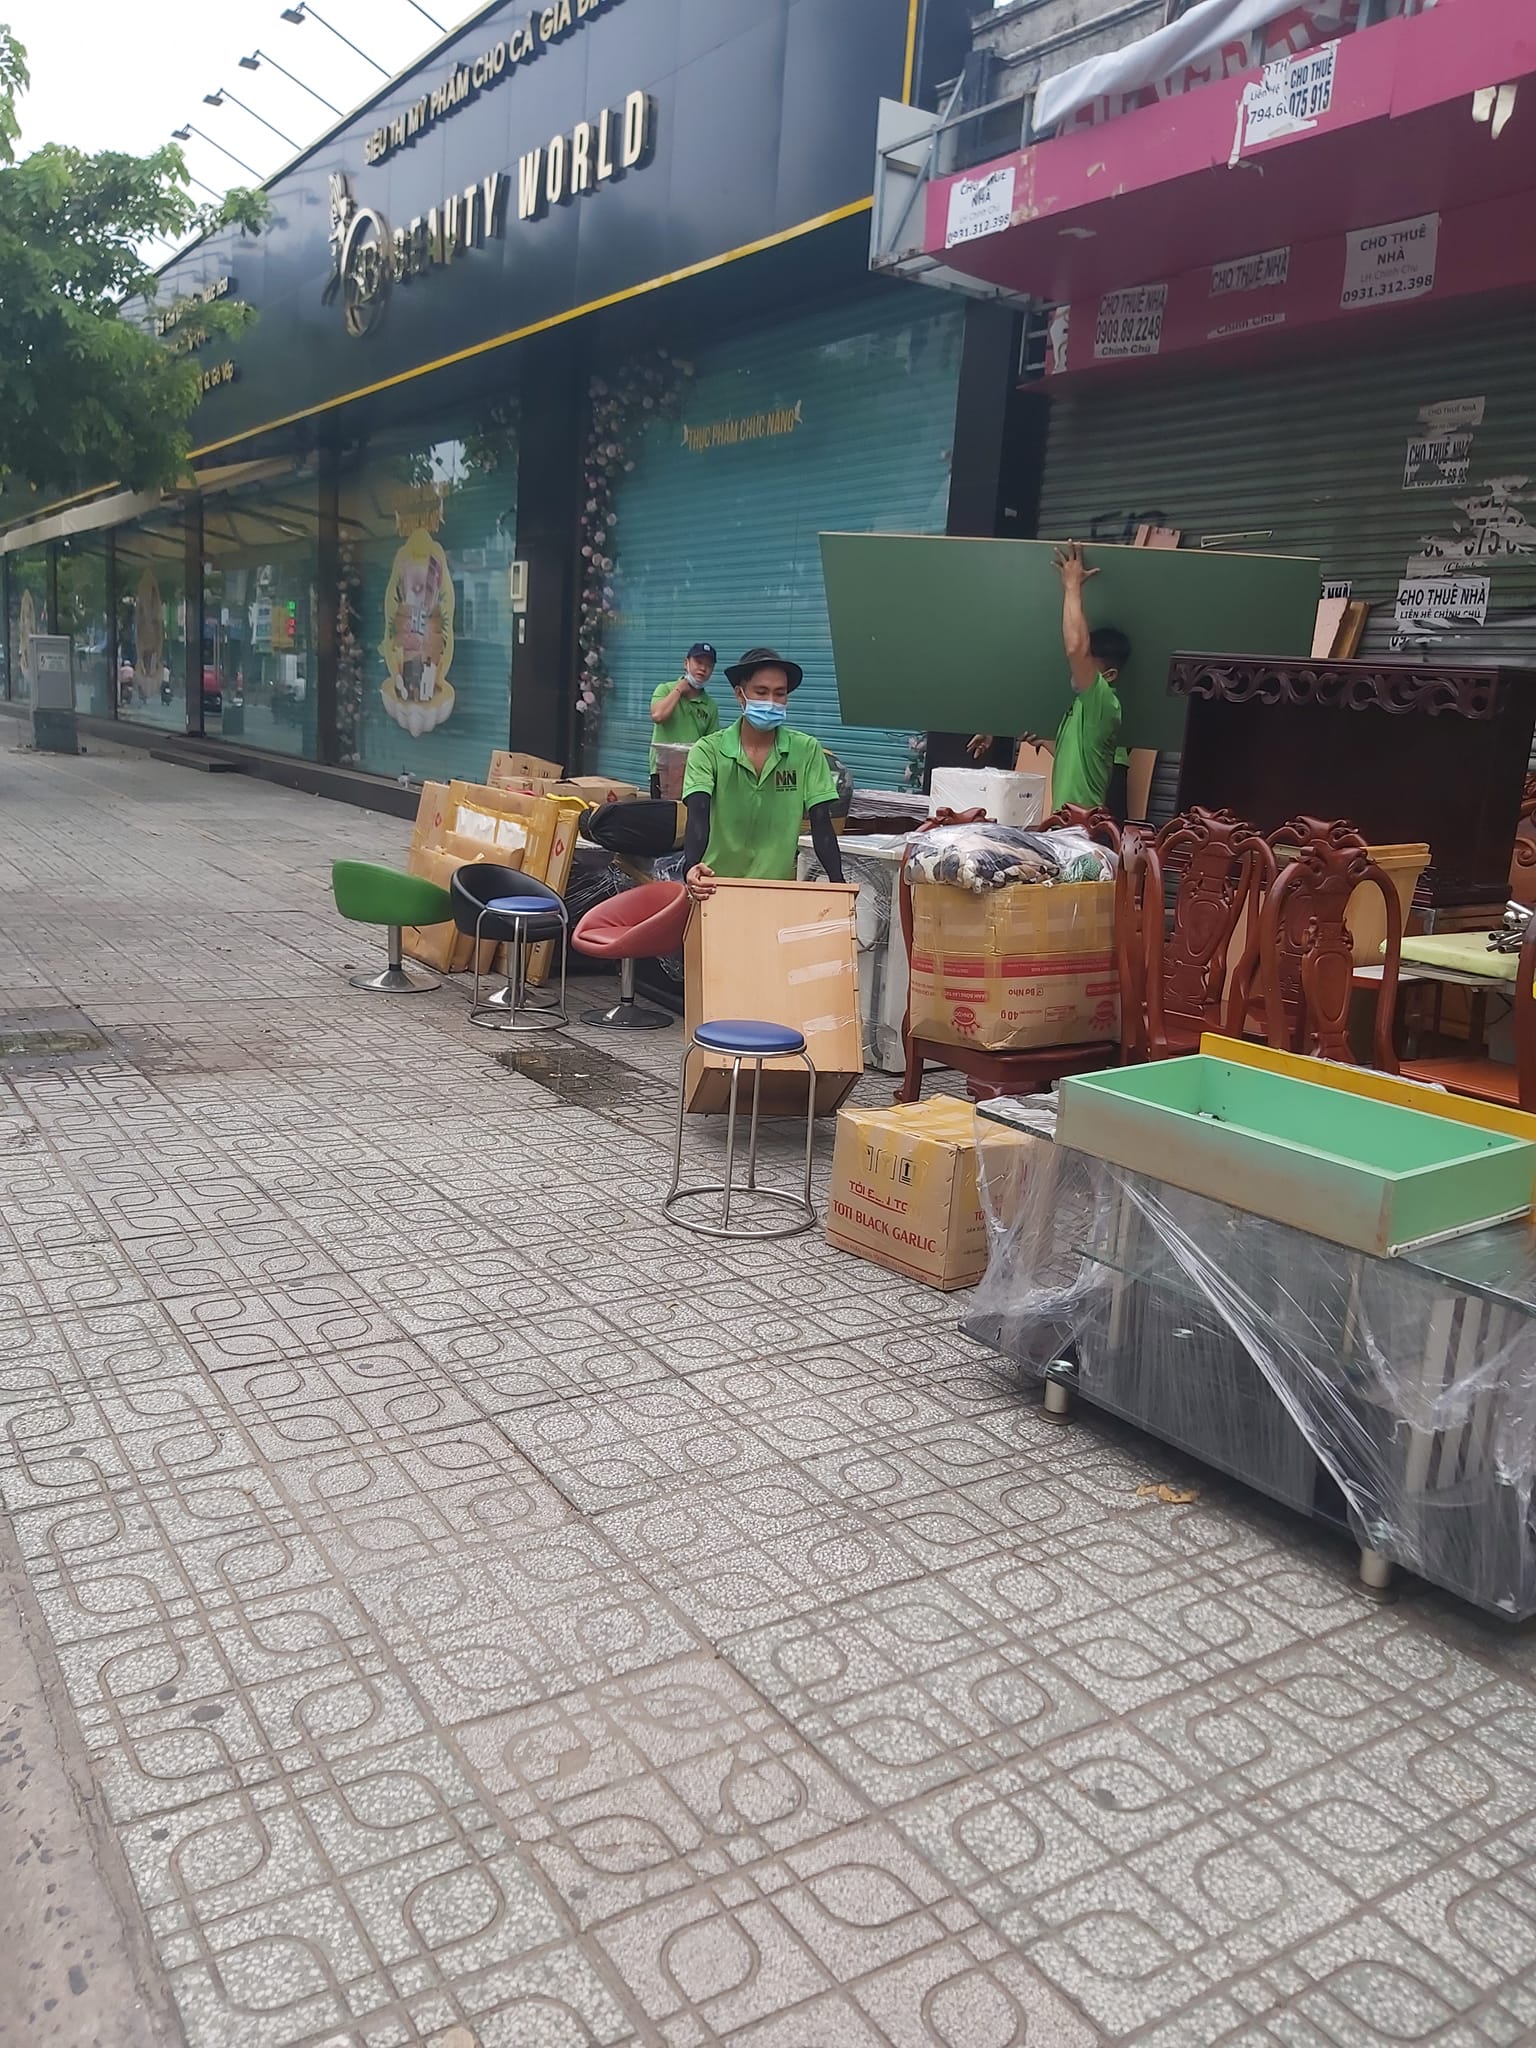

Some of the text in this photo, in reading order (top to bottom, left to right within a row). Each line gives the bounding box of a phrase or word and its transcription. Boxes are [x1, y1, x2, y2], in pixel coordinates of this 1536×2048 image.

[364, 127, 387, 165] SIÊU
[430, 62, 469, 120] PHẨM
[472, 41, 505, 89] CHO
[509, 10, 534, 63] CẢ
[539, 0, 572, 42] GIA
[1290, 66, 1308, 88] CHO
[1310, 80, 1330, 113] 915
[517, 90, 646, 220] WORLD
[1360, 223, 1427, 251] CHO THUÊ
[1377, 246, 1405, 265] NHÀ
[1342, 274, 1433, 302] 0931.312.398
[1399, 582, 1485, 606] CHO THUÊ NHÀ
[833, 1199, 937, 1254] TOTI BLACK GARLIC
